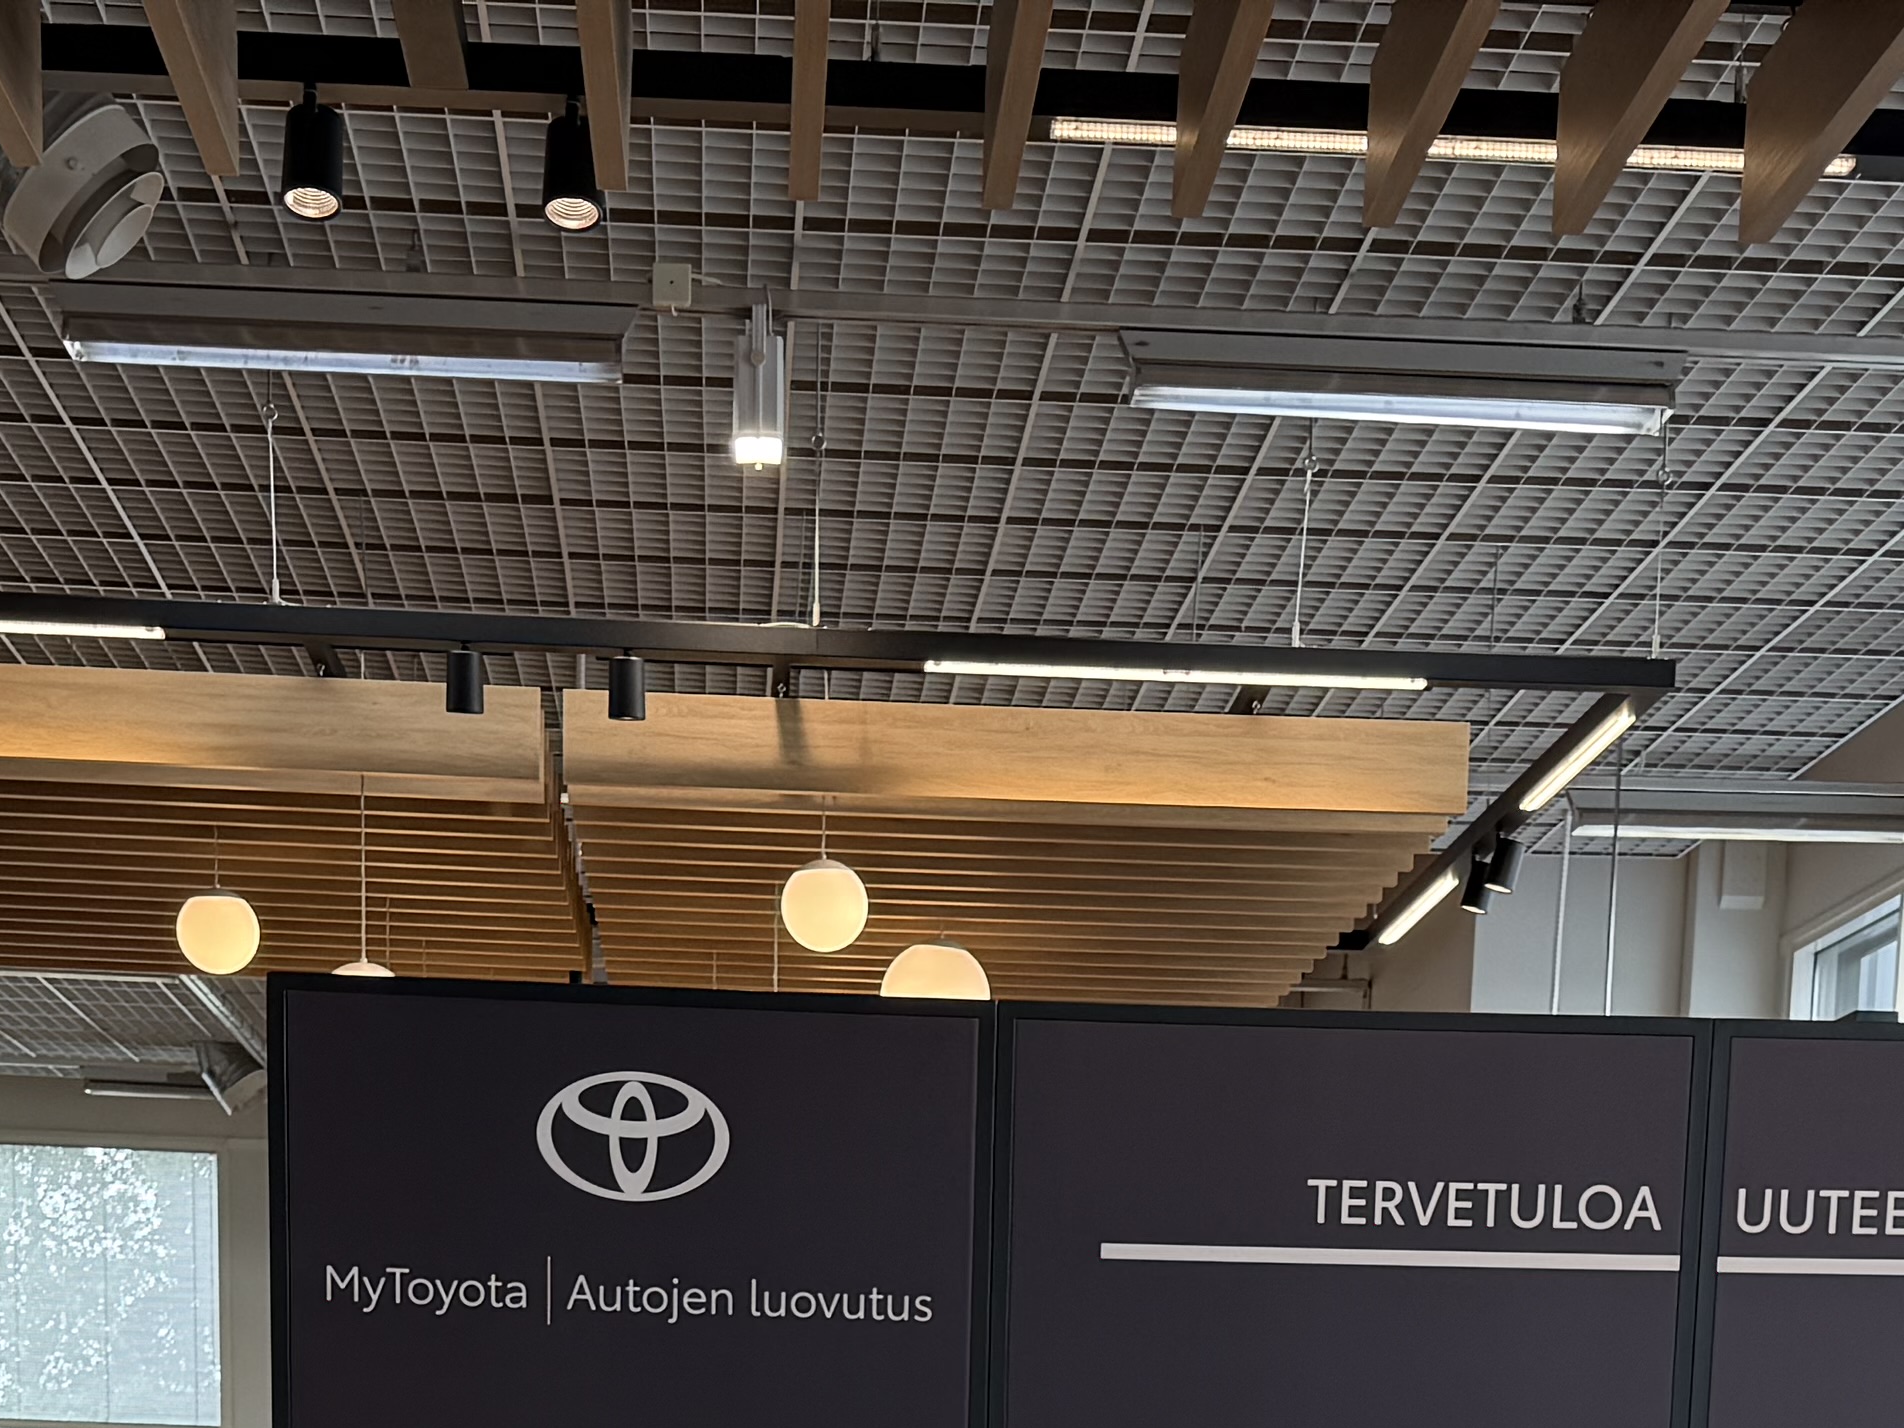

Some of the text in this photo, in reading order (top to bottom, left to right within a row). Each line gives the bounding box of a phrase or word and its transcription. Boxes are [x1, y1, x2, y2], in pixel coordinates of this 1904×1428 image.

[1307, 1178, 1663, 1231] TERVETULOA
[326, 1265, 933, 1324] MyToyota Autojen luovutus
